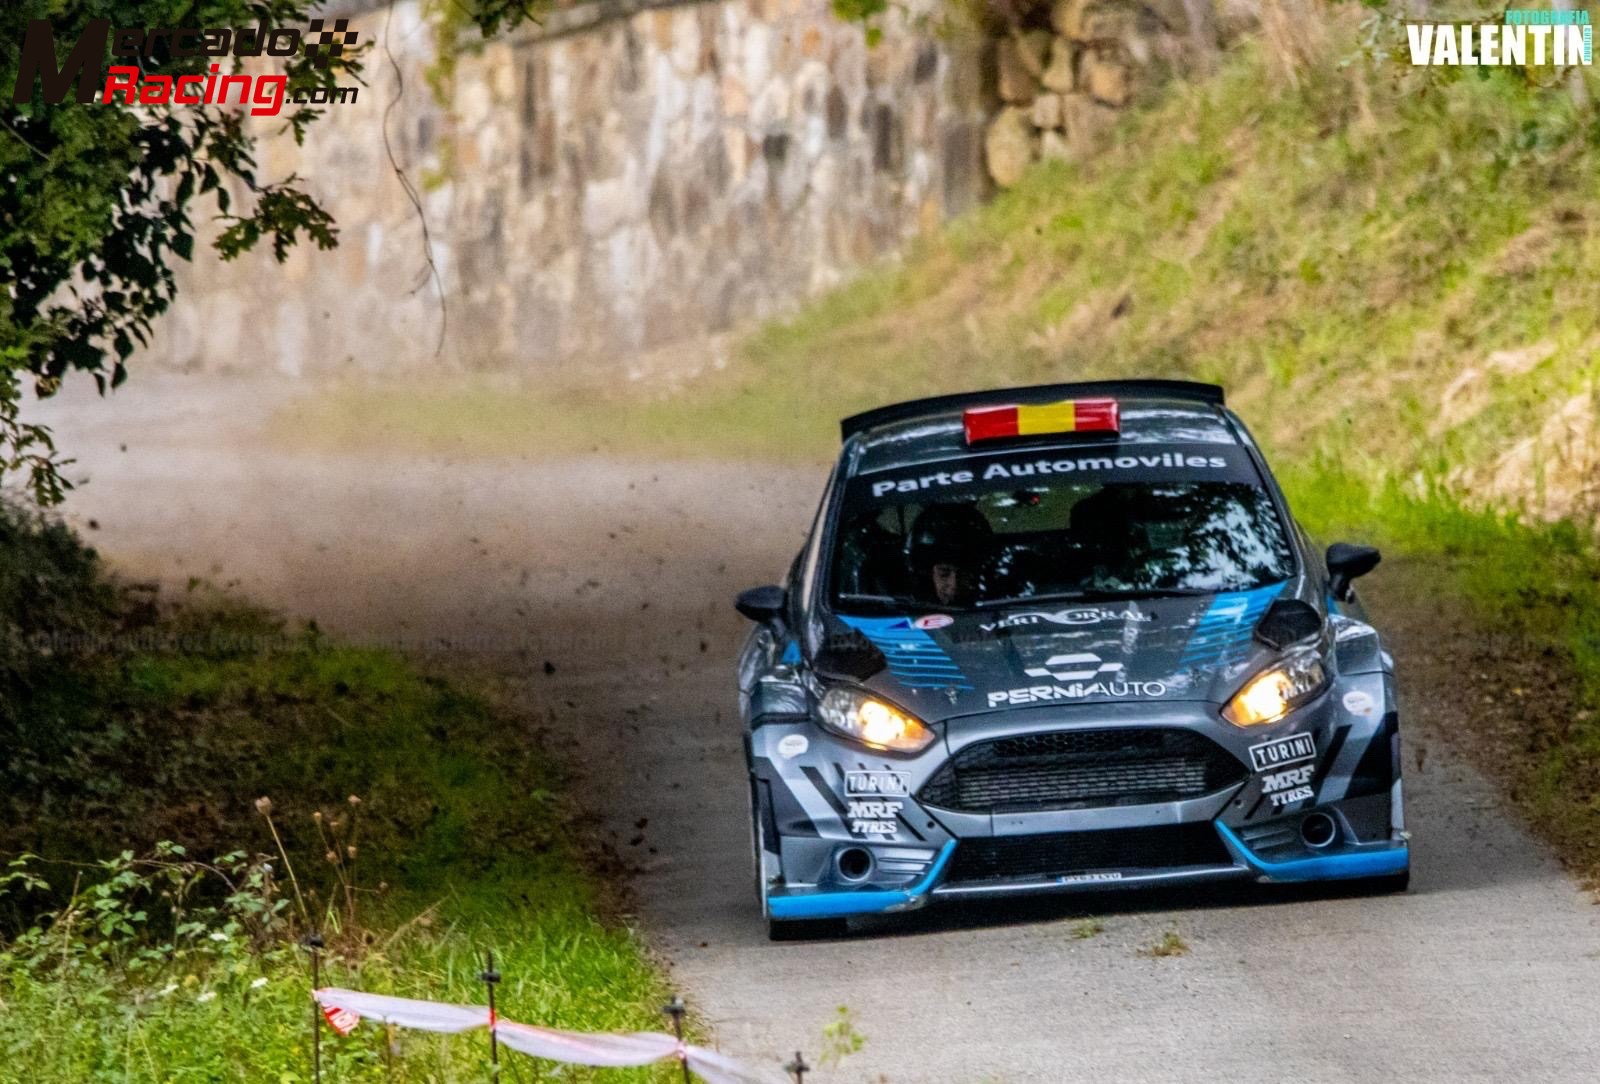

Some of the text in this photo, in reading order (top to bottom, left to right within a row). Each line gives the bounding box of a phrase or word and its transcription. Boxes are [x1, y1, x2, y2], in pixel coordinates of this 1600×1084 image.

[872, 452, 1227, 497] Parte Automoviles
[1256, 738, 1312, 765] TURINI
[849, 775, 905, 792] TURINI
[1262, 764, 1315, 793] MRF
[1270, 785, 1315, 807] TYRES
[847, 801, 904, 818] MRF
[851, 820, 898, 833] TYRES
